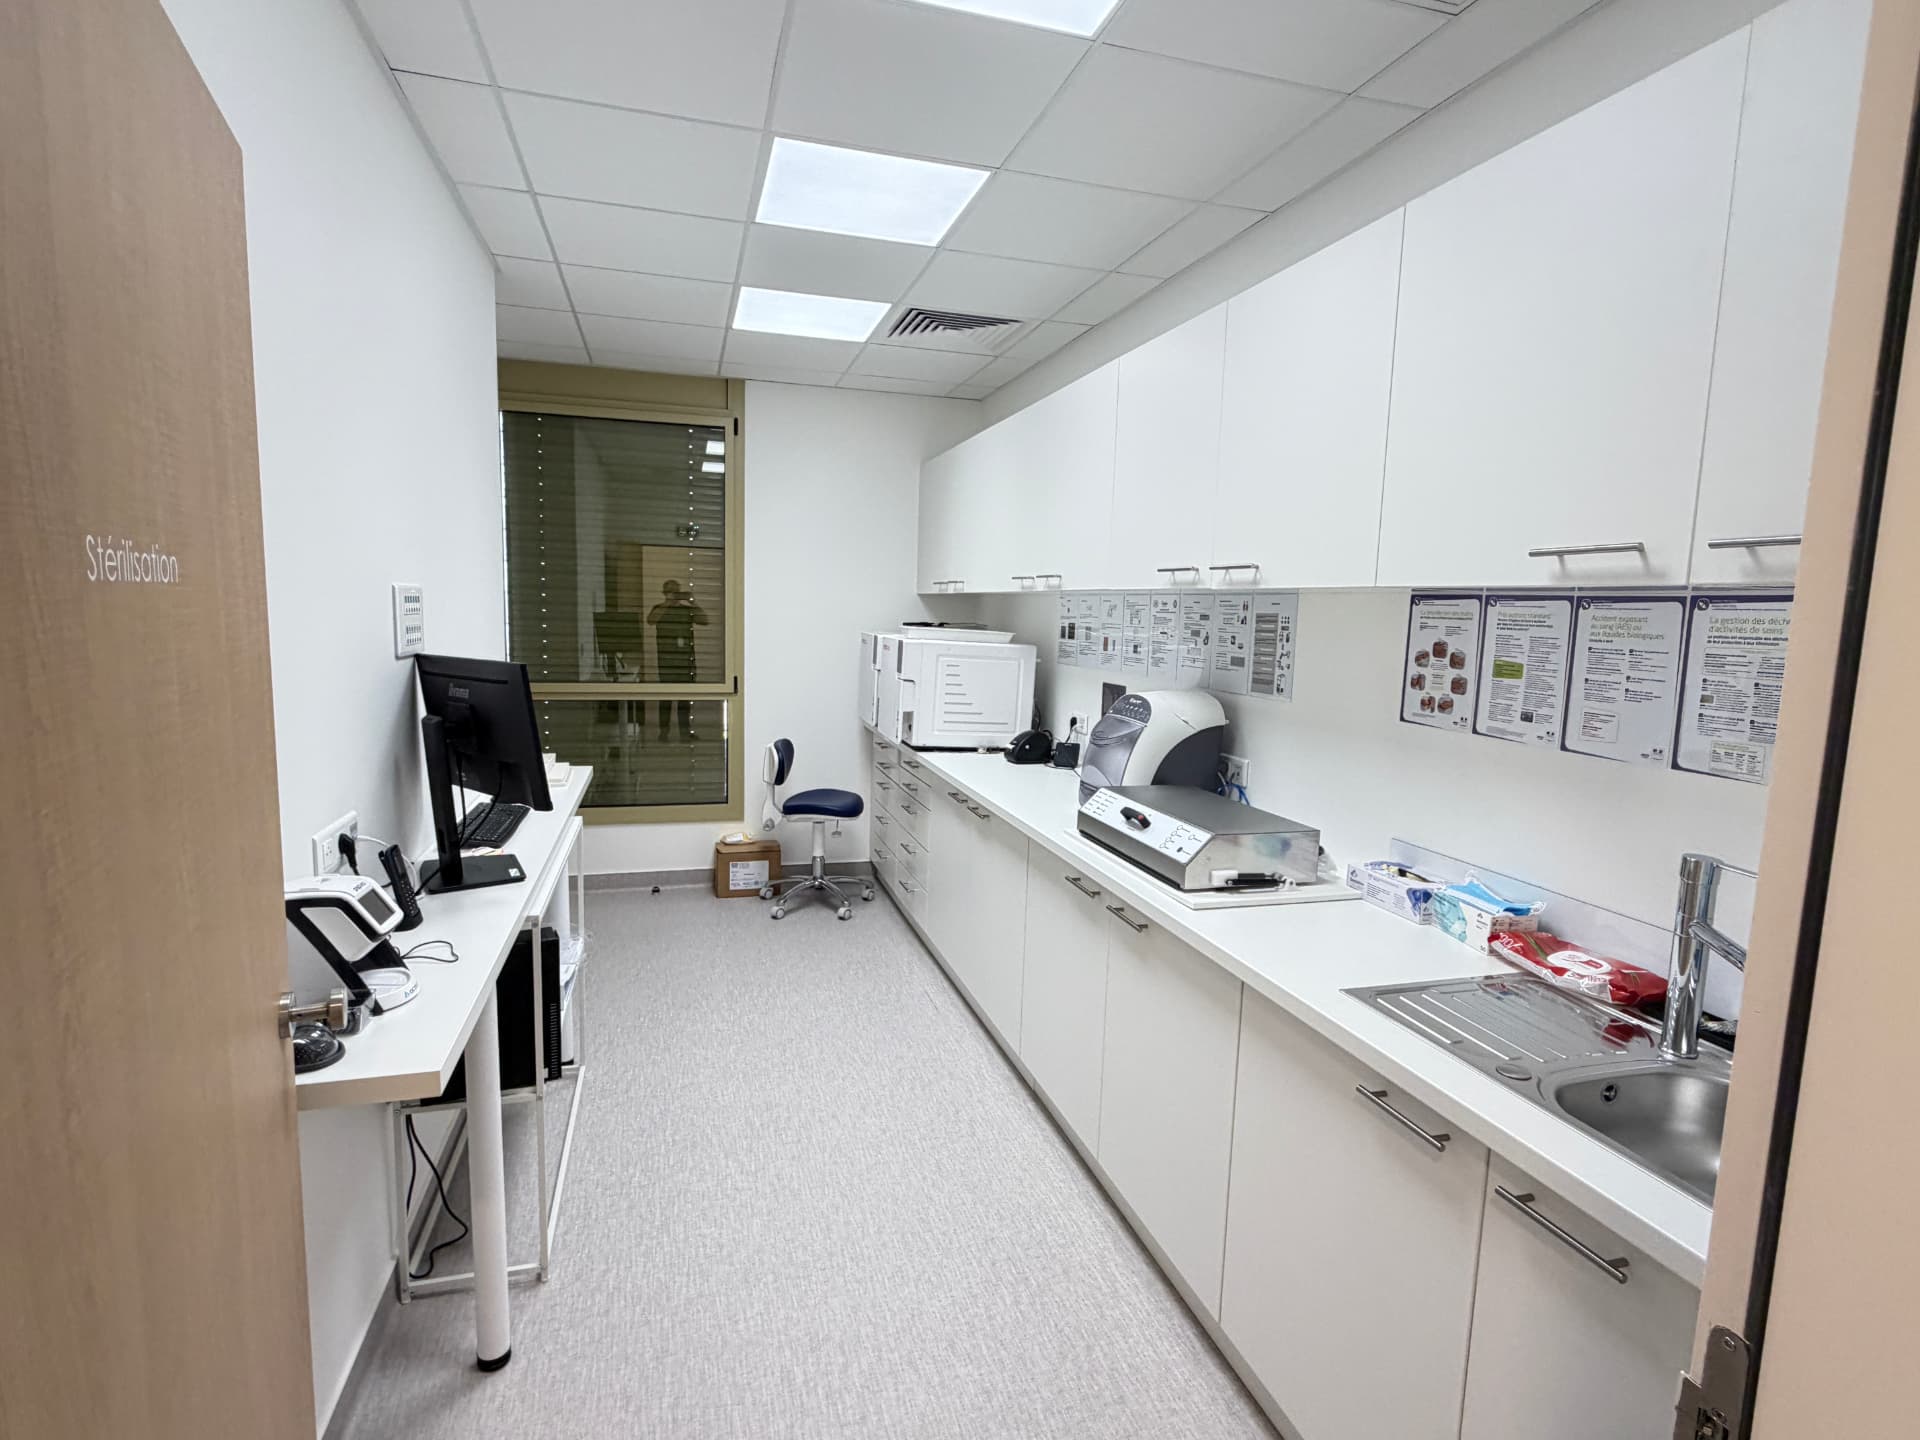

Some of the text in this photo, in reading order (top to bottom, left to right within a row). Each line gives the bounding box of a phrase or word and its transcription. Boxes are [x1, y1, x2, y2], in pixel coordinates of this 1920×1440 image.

[85, 534, 179, 584] Stérilisation
[1709, 616, 1720, 624] La
[1720, 617, 1750, 626] gestion
[1751, 617, 1766, 625] des
[1749, 626, 1760, 634] de
